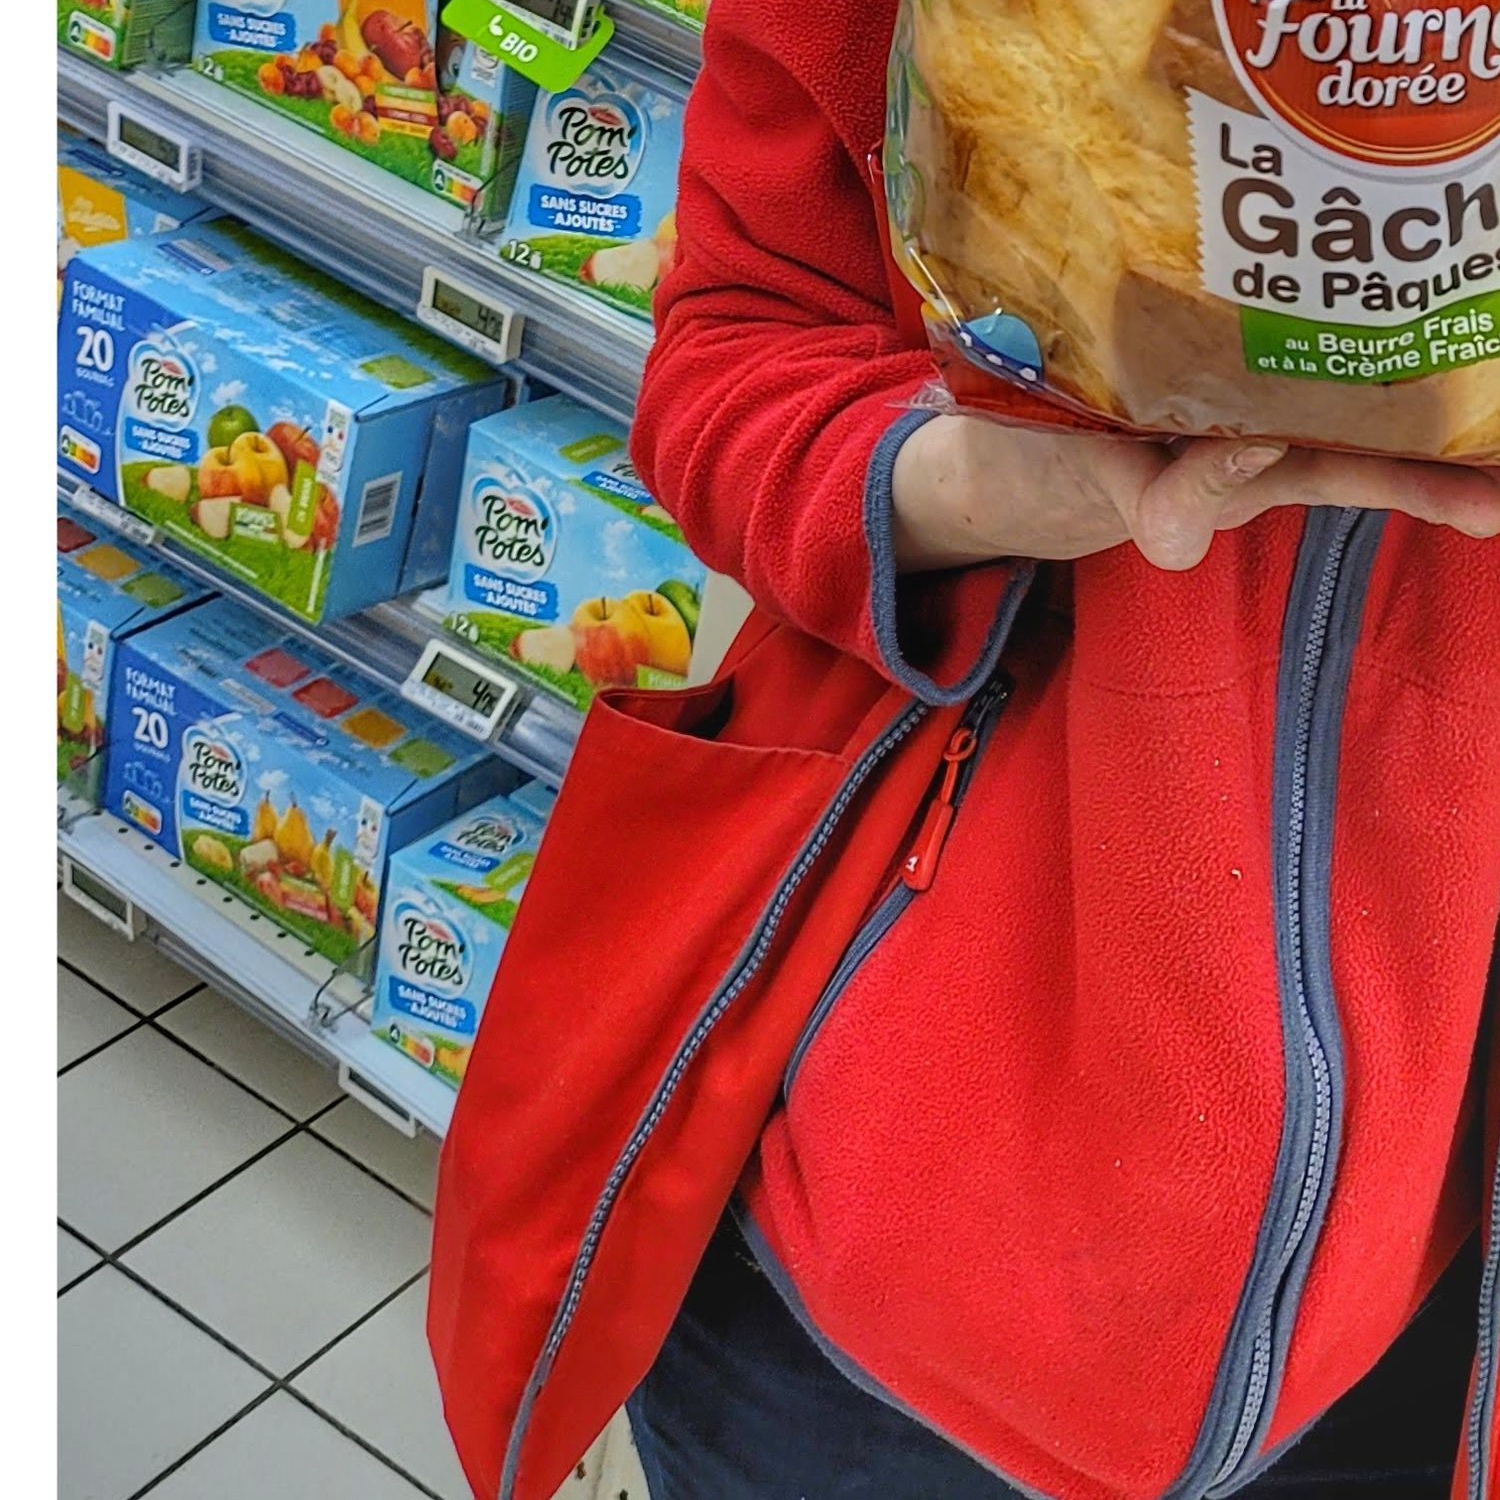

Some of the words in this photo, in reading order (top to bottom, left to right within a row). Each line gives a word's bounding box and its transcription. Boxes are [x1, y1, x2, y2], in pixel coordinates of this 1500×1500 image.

[500, 31, 539, 63] BIO
[1317, 62, 1468, 108] dorée
[547, 140, 629, 179] Potes
[1220, 122, 1283, 176] La
[541, 195, 576, 213] SANS
[579, 200, 627, 219] SUCRES
[509, 240, 529, 263] 12
[73, 281, 125, 312] FORMAT
[1232, 262, 1300, 303] de
[76, 326, 114, 371] 20
[1286, 337, 1309, 353] au
[1318, 329, 1414, 356] Beurre
[1424, 308, 1493, 340] Frais
[1258, 354, 1278, 369] et
[1282, 354, 1295, 371] à
[1300, 357, 1317, 373] la
[1326, 349, 1420, 378] Crème
[135, 387, 189, 417] Potes
[476, 526, 544, 568] Potes
[474, 574, 502, 594] SANS
[504, 582, 547, 604] SUCRES
[126, 667, 176, 699] FORMAT
[132, 707, 168, 749] 20
[189, 763, 239, 796] Potes
[398, 948, 463, 986] Potes
[399, 985, 430, 1002] SANS
